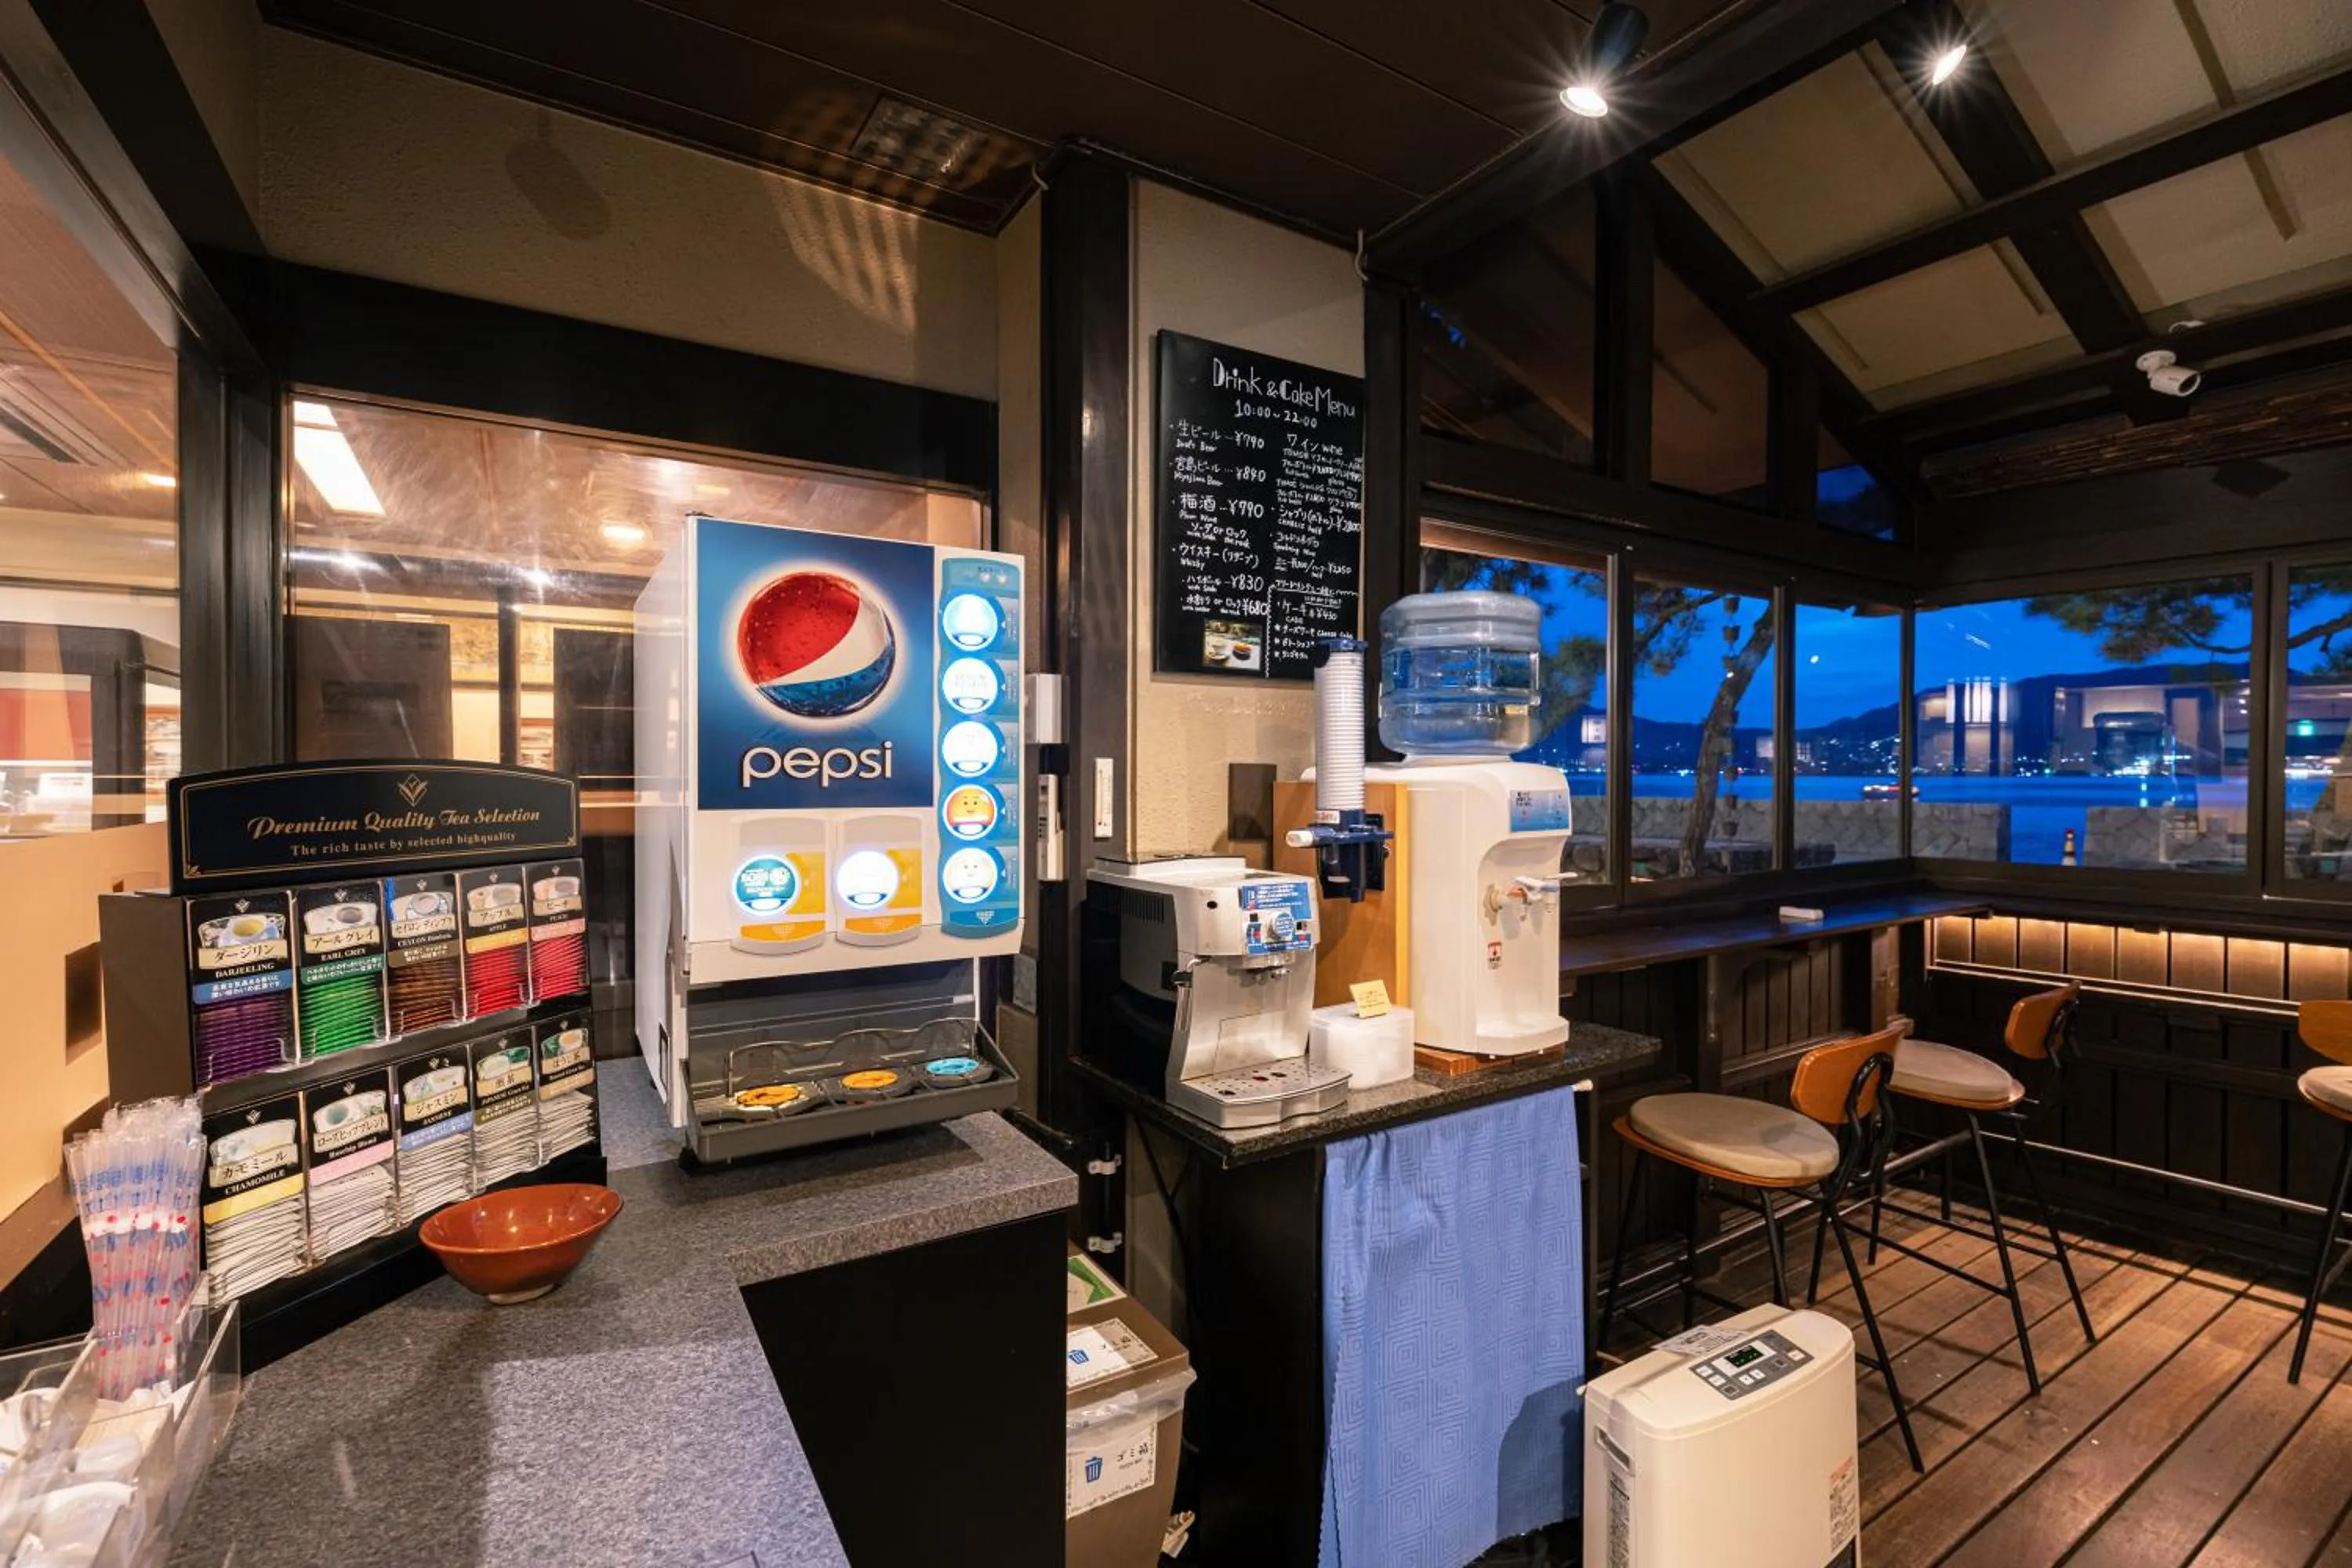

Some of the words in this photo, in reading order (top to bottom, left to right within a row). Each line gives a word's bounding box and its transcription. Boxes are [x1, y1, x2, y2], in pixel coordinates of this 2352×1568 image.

[1213, 358, 1262, 396] Drink
[1266, 379, 1279, 398] &
[1315, 385, 1356, 417] Menu
[1178, 419, 1222, 440] 生ビール
[1234, 430, 1265, 449] ¥790
[1236, 466, 1266, 482] ¥890
[1179, 492, 1216, 513] 梅酒
[1228, 499, 1265, 518] ¥790
[1229, 573, 1265, 592] ¥830
[742, 741, 894, 788] pepsi
[248, 816, 358, 840] Premium
[364, 811, 435, 833] Quality
[439, 809, 470, 826] Tea
[474, 807, 541, 824] Selection
[290, 844, 317, 856] The
[322, 842, 350, 855] rich
[354, 840, 386, 851] taste
[390, 839, 403, 851] by
[408, 835, 452, 848] selected
[312, 928, 374, 949] アールグレイ
[214, 944, 276, 964] ダージリン
[321, 951, 343, 962] EARL
[216, 962, 275, 979] DARJEELING
[416, 1092, 459, 1114] ジャスミン
[223, 1150, 288, 1180] カモミール
[225, 1168, 286, 1196] CHAMOMILE
